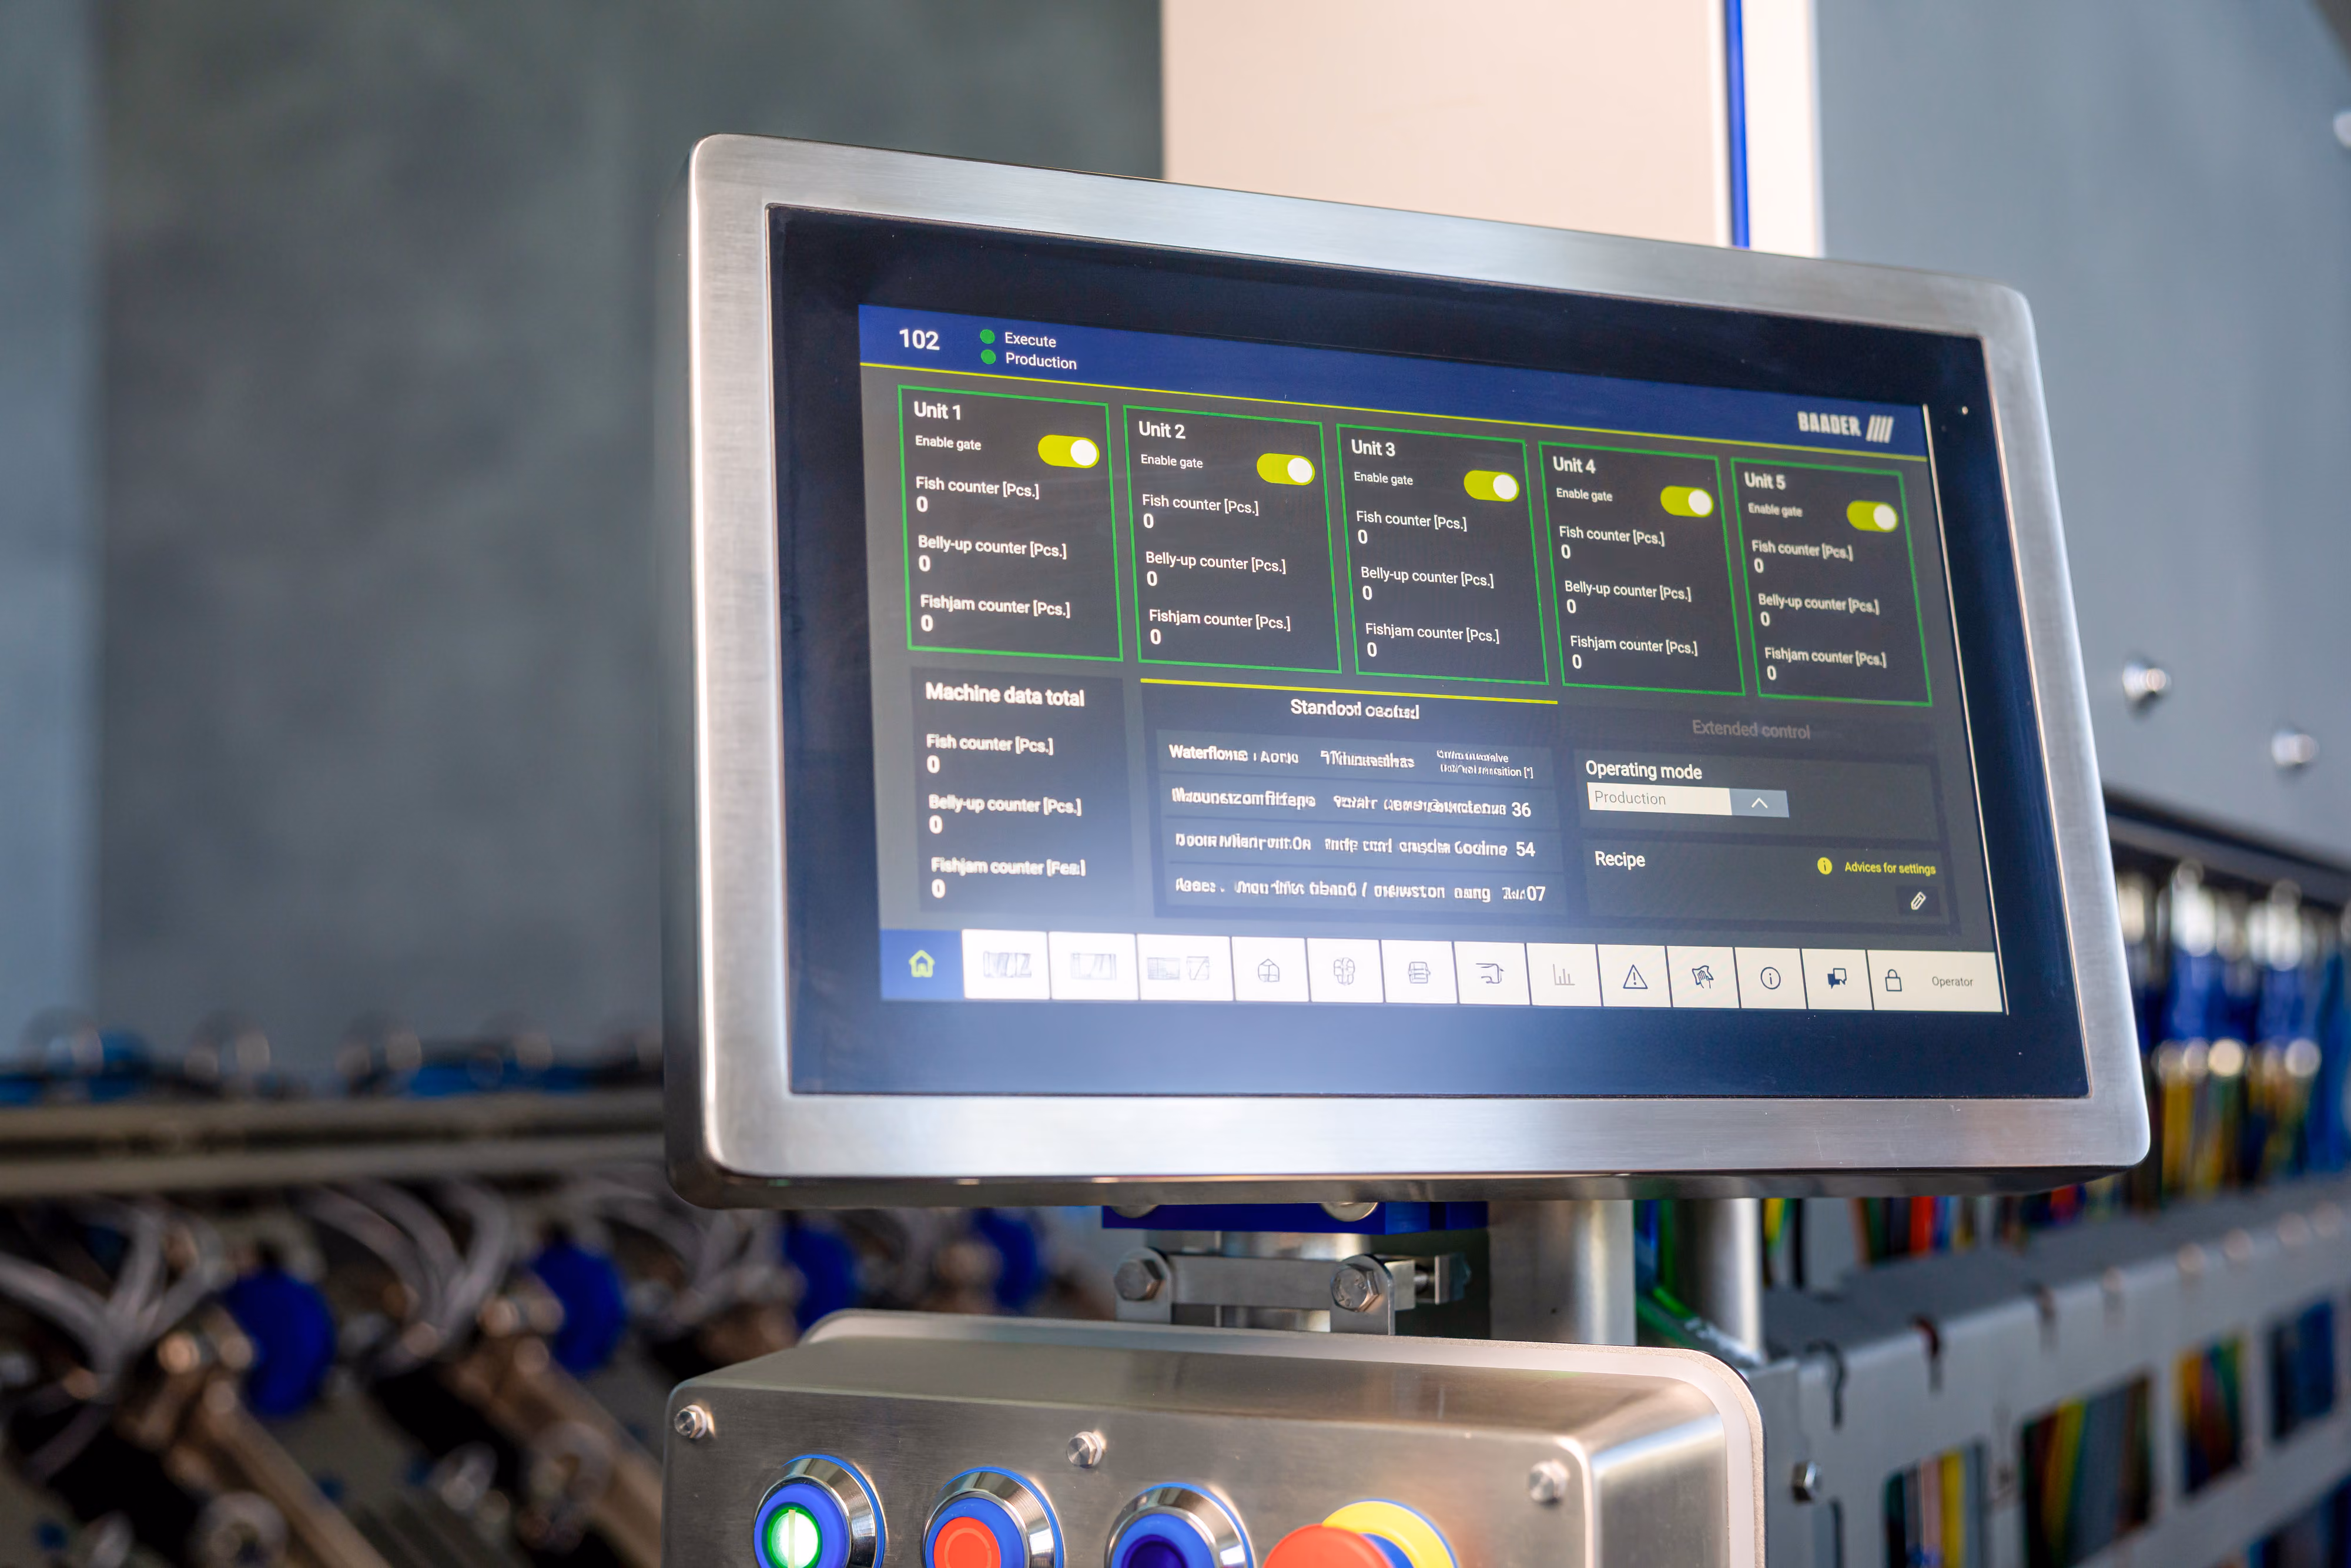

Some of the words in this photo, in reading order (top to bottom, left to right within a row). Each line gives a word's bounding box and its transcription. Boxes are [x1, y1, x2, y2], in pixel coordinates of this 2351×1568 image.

[899, 329, 940, 351] 102
[1004, 331, 1057, 348] Execute
[1006, 352, 1077, 370] Production
[913, 401, 949, 420] Unit
[952, 404, 961, 420] 1
[1138, 420, 1172, 438] Unit
[1174, 424, 1186, 440] 2
[1797, 411, 1861, 437] BAADER
[915, 435, 954, 448] Enable
[956, 440, 982, 452] gate
[1351, 438, 1383, 456] Unit
[1385, 442, 1396, 457] 3
[1141, 454, 1177, 467] Enable
[1179, 458, 1203, 470] gate
[1553, 455, 1583, 473] Unit
[1585, 458, 1596, 474] 4
[916, 475, 945, 491] Fish
[947, 481, 1000, 495] counter
[1002, 481, 1040, 500] [Pcs.]
[1354, 471, 1388, 484] Enable
[1391, 475, 1414, 487] gate
[1744, 471, 1774, 490] Unit
[1776, 474, 1786, 490] 5
[916, 495, 928, 512] 0
[1556, 487, 1589, 500] Enable
[1590, 491, 1613, 503] gate
[1142, 494, 1170, 508] Fish
[1173, 498, 1221, 511] counter
[1224, 498, 1259, 517] [Pcs.]
[1747, 502, 1780, 515] Enable
[1781, 506, 1803, 518] gate
[1143, 512, 1154, 529] 0
[1356, 510, 1382, 524] Fish
[1385, 515, 1432, 527] counter
[1434, 514, 1467, 532] [Pcs.]
[1358, 529, 1368, 544] 0
[1559, 525, 1584, 539] Fish
[1586, 530, 1631, 542] counter
[1632, 529, 1665, 547] [Pcs.]
[918, 534, 973, 554] Belly-up
[975, 541, 1027, 555] counter
[1030, 541, 1067, 560] [Pcs.]
[1560, 544, 1571, 559] 0
[1751, 540, 1776, 554] Fish
[1777, 544, 1820, 557] counter
[1821, 542, 1854, 562] [Pcs.]
[918, 555, 931, 572] 0
[1146, 551, 1197, 569] Belly-up
[1200, 557, 1248, 570] counter
[1251, 557, 1287, 575] [Pcs.]
[1754, 558, 1764, 574] 0
[1147, 571, 1158, 587] 0
[1361, 566, 1409, 584] Belly-up
[1412, 572, 1458, 584] counter
[1461, 571, 1494, 589] [Pcs.]
[1362, 585, 1372, 601] 0
[1565, 580, 1610, 598] Belly-up
[1613, 585, 1657, 598] counter
[1659, 585, 1692, 602] [Pcs.]
[920, 594, 976, 612] Fishjam
[978, 600, 1030, 614] counter
[1033, 599, 1071, 619] [Pcs.]
[1566, 598, 1576, 614] 0
[1758, 592, 1803, 611] Belly-up
[1804, 598, 1847, 611] counter
[1847, 597, 1880, 615] [Pcs.]
[920, 614, 933, 632] 0
[1149, 609, 1201, 626] Fishjam
[1203, 615, 1253, 627] counter
[1255, 614, 1291, 632] [Pcs.]
[1760, 611, 1770, 626] 0
[1150, 628, 1161, 645] 0
[1365, 622, 1414, 639] Fishjam
[1417, 628, 1463, 640] counter
[1466, 627, 1500, 645] [Pcs.]
[1367, 642, 1377, 658] 0
[1570, 635, 1617, 651] Fishjam
[1619, 640, 1663, 652] counter
[1665, 639, 1698, 657] [Pcs.]
[1572, 654, 1582, 669] 0
[1764, 646, 1810, 663] Fishjam
[1811, 652, 1854, 664] counter
[1855, 650, 1887, 669] [Pcs.]
[1767, 665, 1777, 681] 0
[925, 681, 1001, 703] Machine
[1003, 685, 1043, 705] data
[1044, 689, 1085, 707] total
[1692, 719, 1759, 737] Extended
[1761, 724, 1811, 739] control
[926, 733, 957, 749] Fish
[959, 737, 1013, 752] counter
[1014, 736, 1054, 756] [Pcs.]
[926, 755, 940, 773] 0
[1585, 760, 1657, 782] Operating
[1660, 763, 1703, 780] mode
[928, 793, 985, 814] Belly-up
[987, 798, 1041, 813] counter
[1043, 796, 1082, 817] [Pcs.]
[1595, 790, 1666, 805] Production
[1511, 802, 1532, 817] 36
[929, 815, 943, 834] 0
[1516, 841, 1536, 857] 54
[931, 857, 989, 876] Fishjam
[990, 860, 1045, 875] counter
[1595, 850, 1646, 870] Recipe
[1844, 861, 1882, 873] Advices
[1883, 862, 1897, 873] for
[1898, 863, 1936, 877] settings
[931, 879, 946, 899] 0
[1932, 976, 1973, 989] Operator
